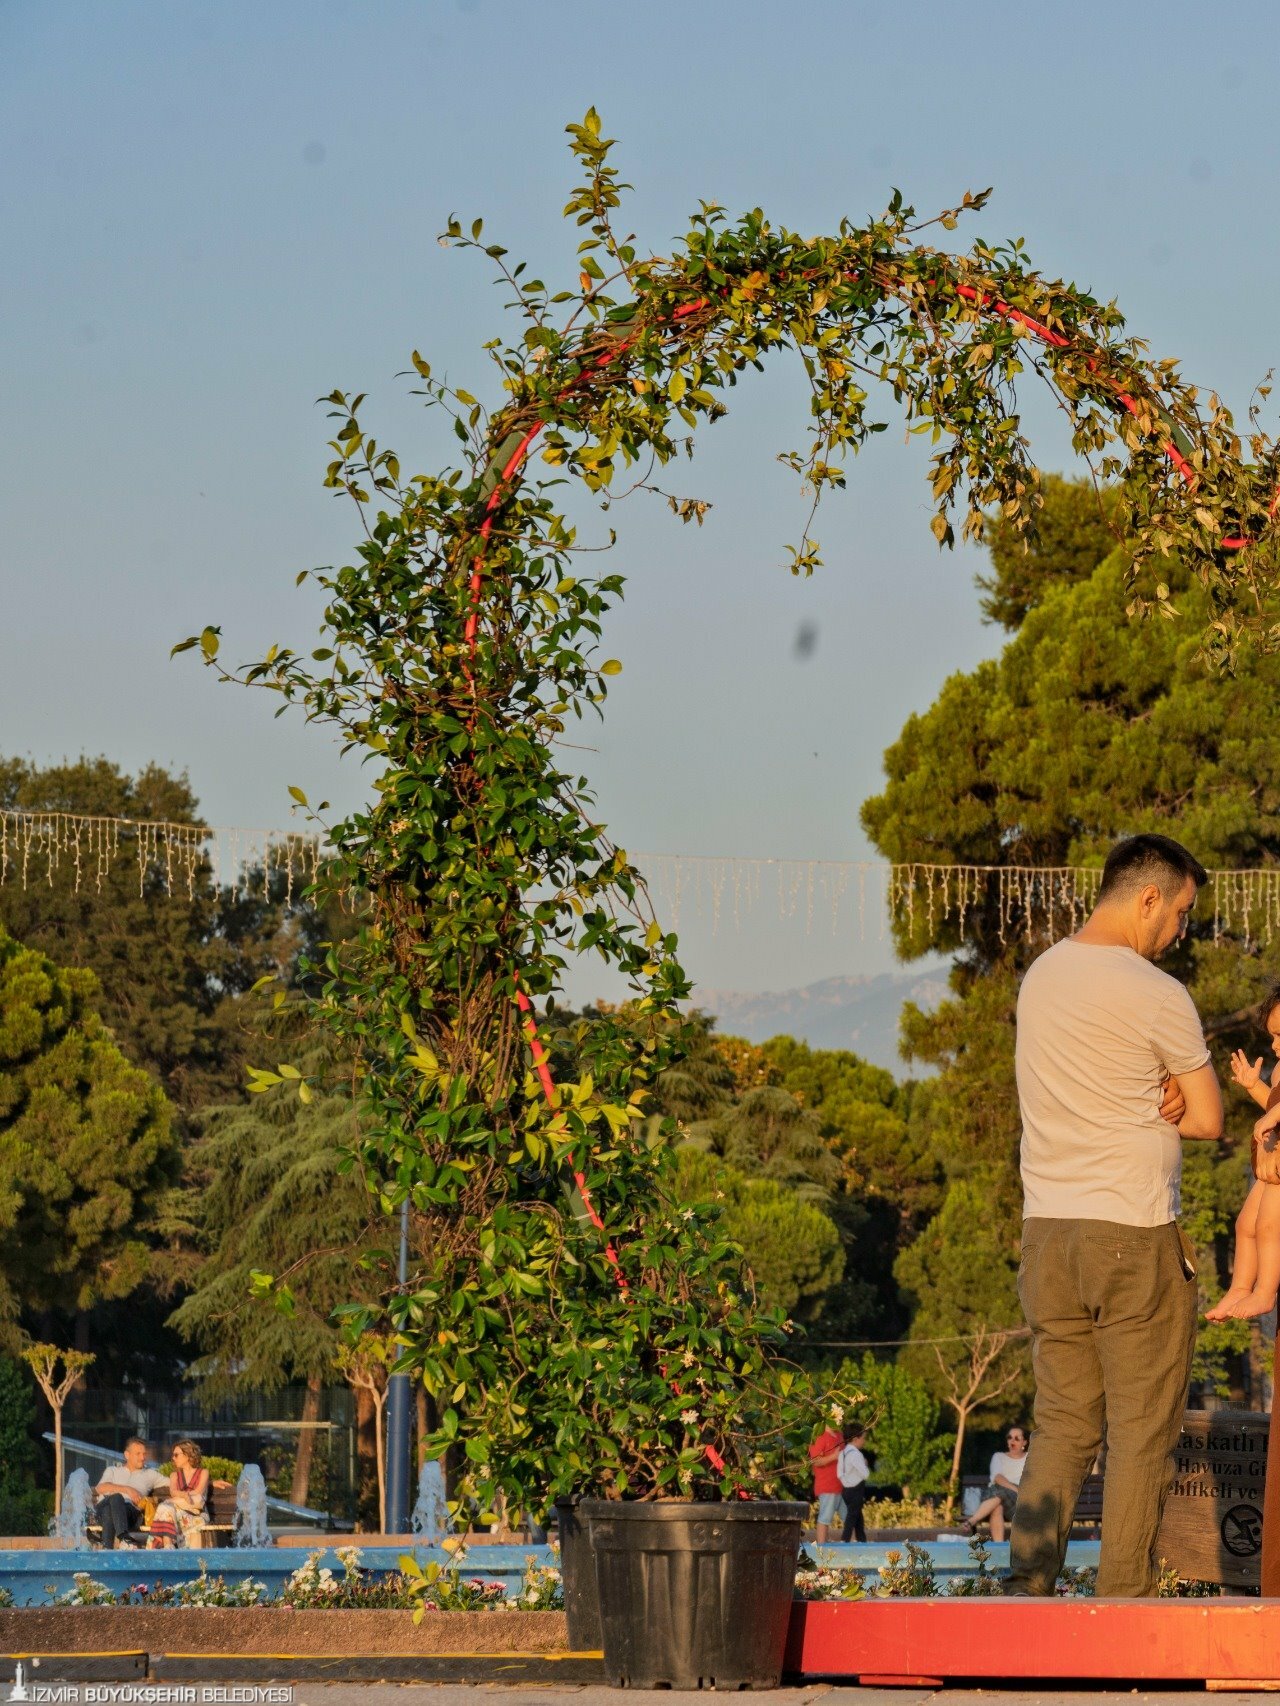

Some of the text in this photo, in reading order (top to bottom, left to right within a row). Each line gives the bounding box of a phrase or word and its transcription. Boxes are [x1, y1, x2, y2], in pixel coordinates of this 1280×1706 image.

[1176, 1431, 1254, 1452] askatlı
[1178, 1457, 1242, 1476] Havuza
[1167, 1480, 1258, 1500] ehlikeli ve
